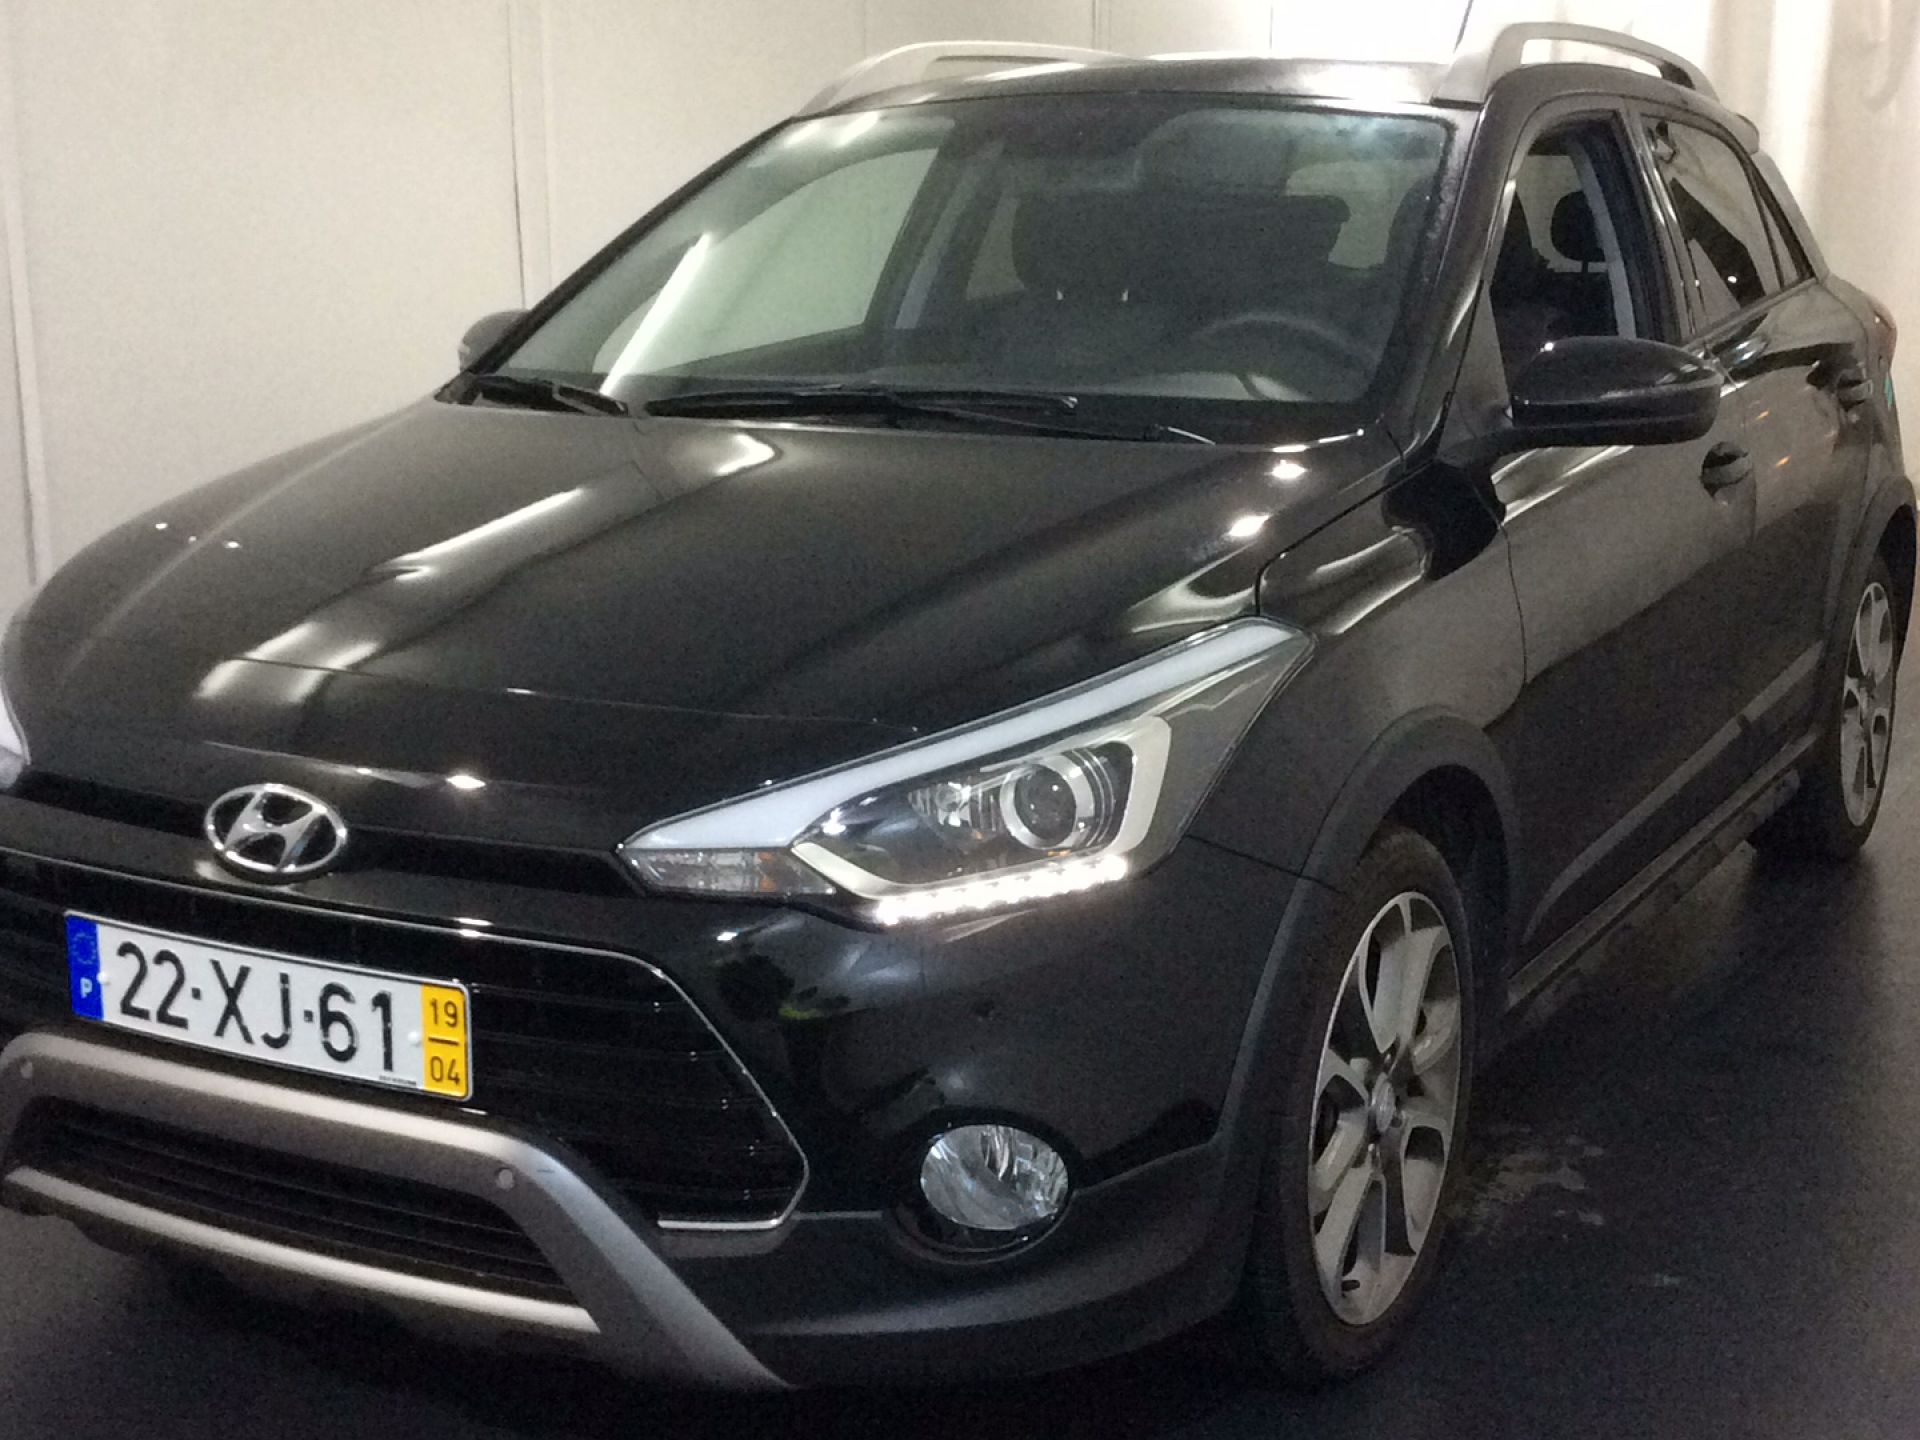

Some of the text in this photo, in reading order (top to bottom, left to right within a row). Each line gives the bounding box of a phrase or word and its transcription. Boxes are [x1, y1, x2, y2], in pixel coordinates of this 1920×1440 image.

[80, 977, 93, 998] P
[429, 998, 459, 1028] 19
[430, 1055, 461, 1085] 04
